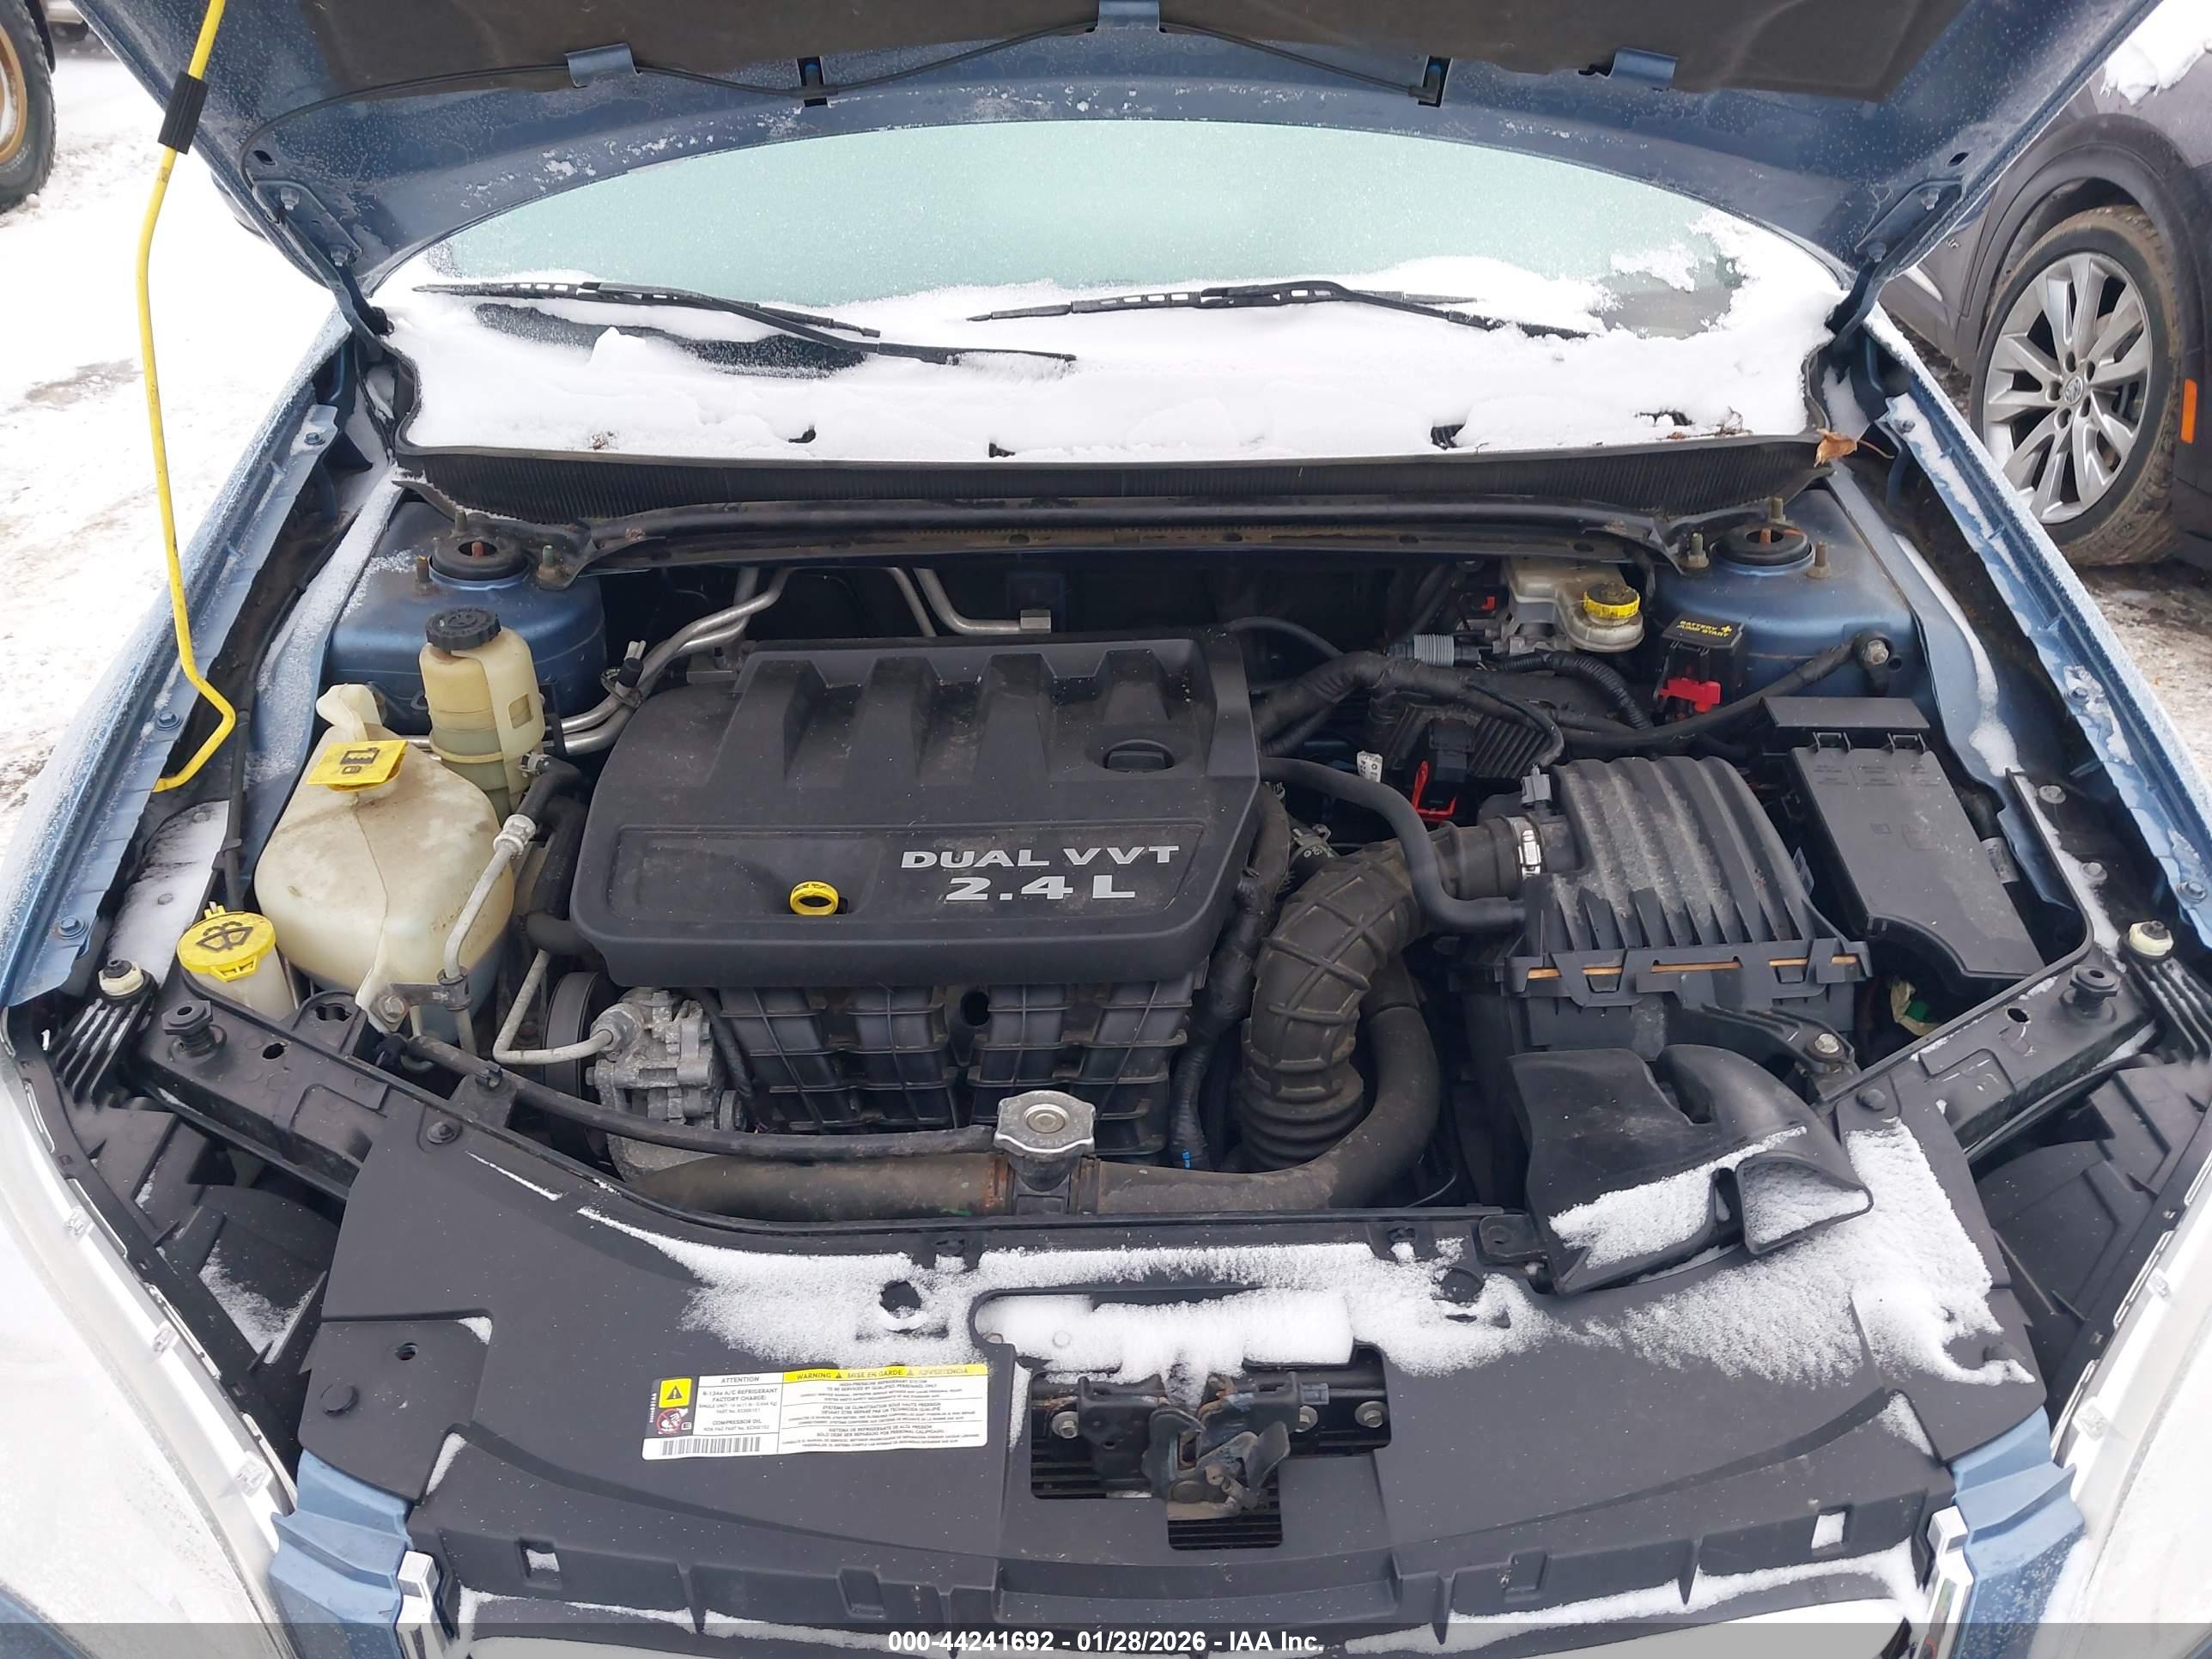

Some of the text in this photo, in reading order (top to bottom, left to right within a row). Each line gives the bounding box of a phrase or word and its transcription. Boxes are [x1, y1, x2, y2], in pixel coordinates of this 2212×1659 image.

[1702, 629, 1729, 637] START
[901, 845, 1180, 869] DUAL VVT
[945, 874, 1136, 901] 2.4 L
